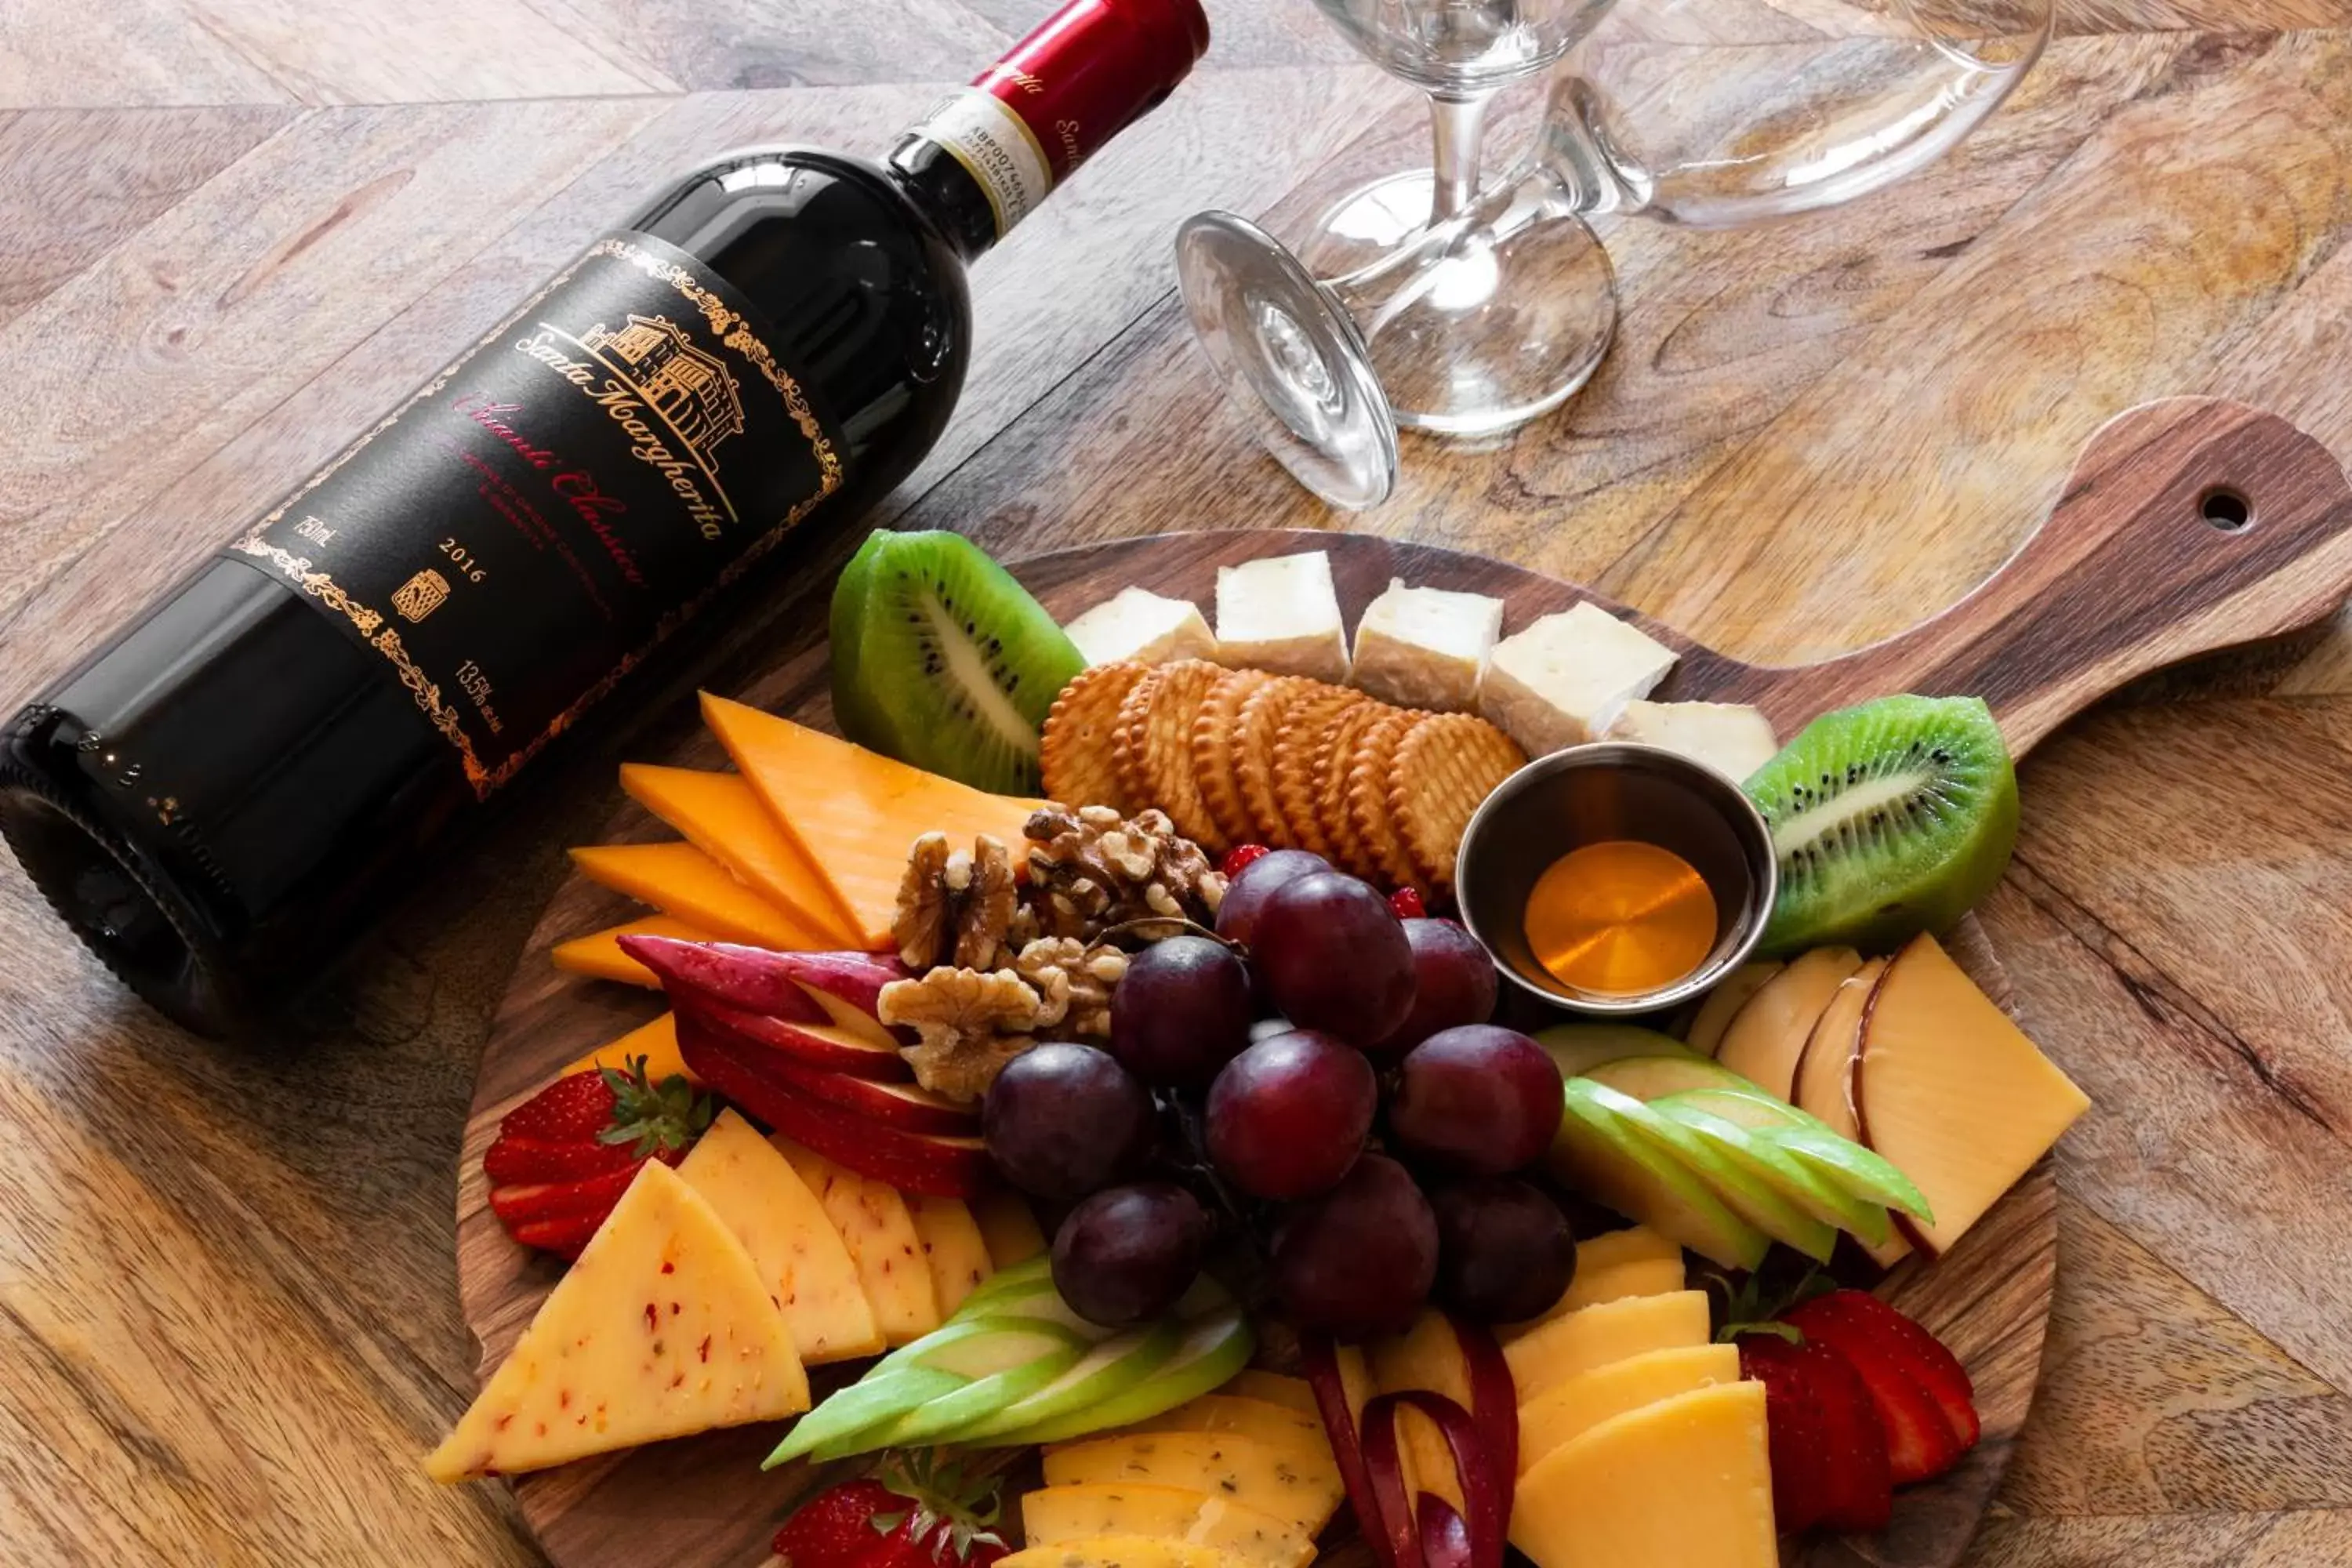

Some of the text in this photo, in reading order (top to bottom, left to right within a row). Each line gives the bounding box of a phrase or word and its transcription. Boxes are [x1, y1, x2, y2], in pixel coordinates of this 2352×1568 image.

[515, 331, 594, 387] Santa
[583, 378, 724, 541] Margherita
[438, 537, 487, 583] 2016
